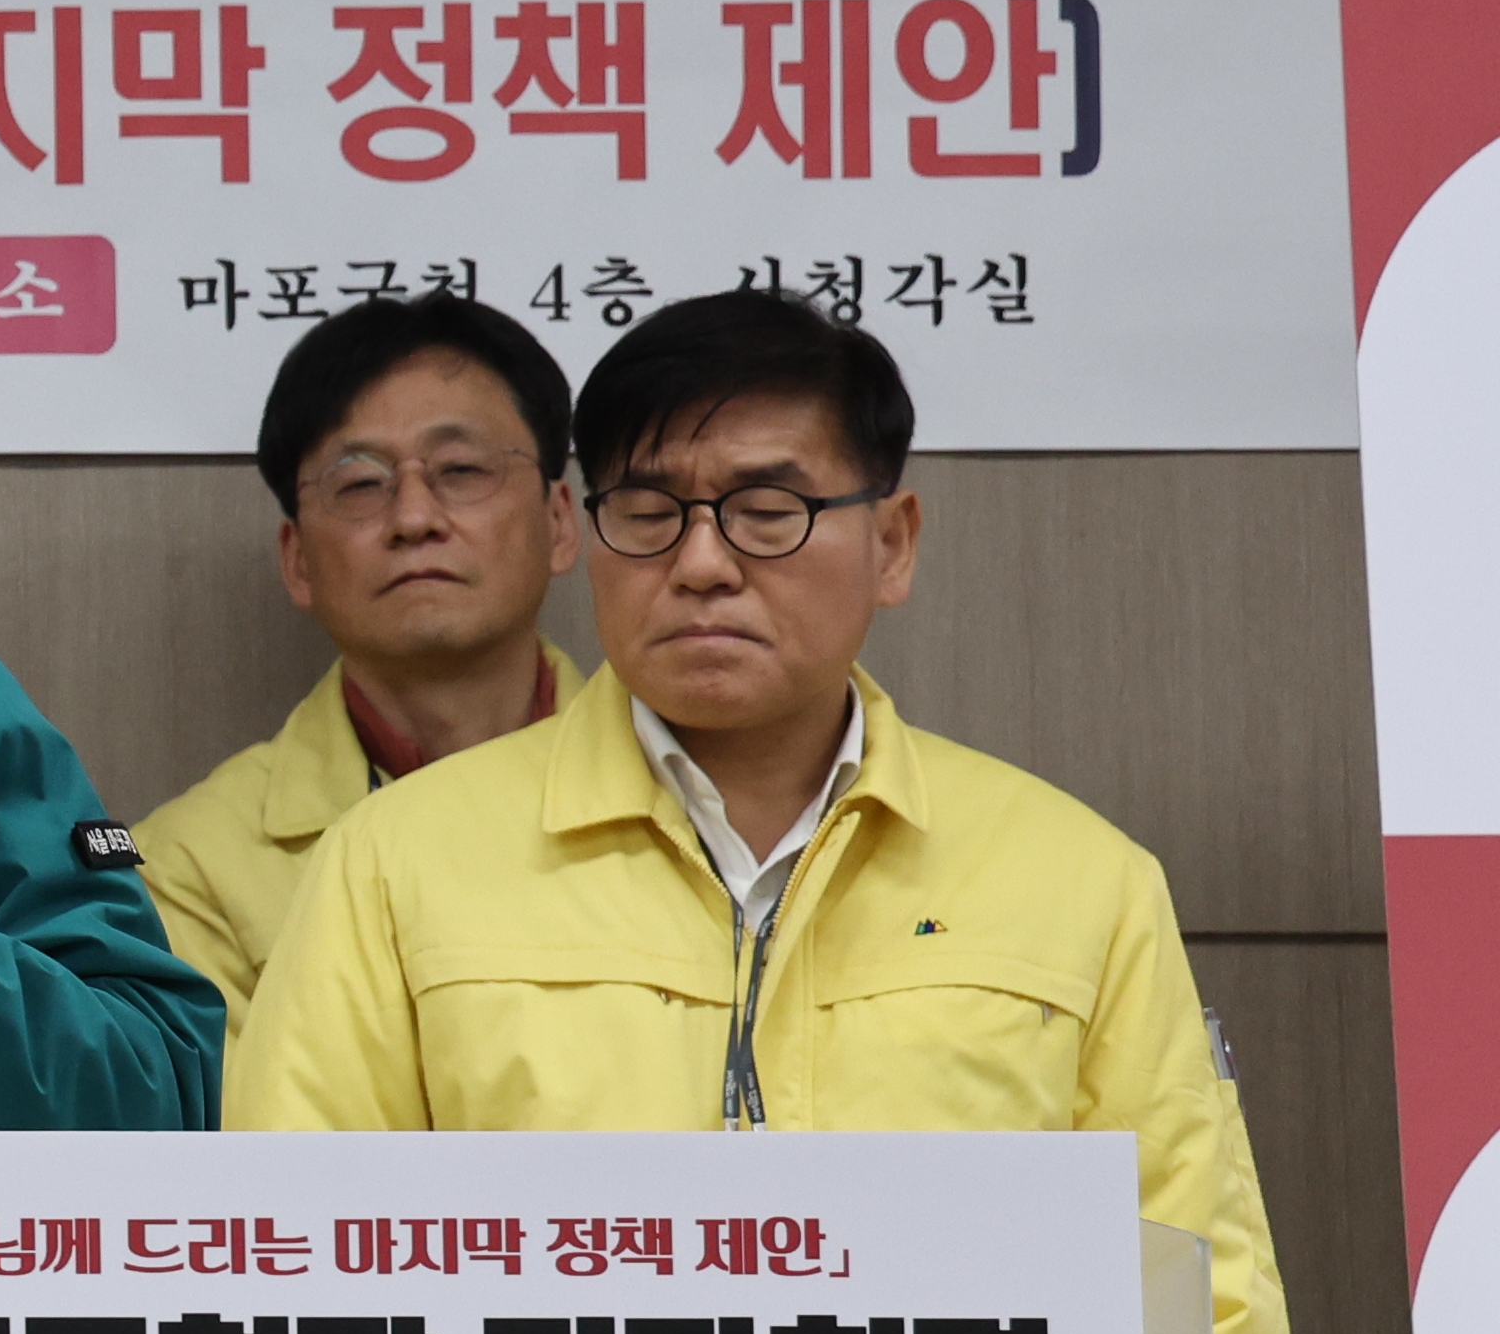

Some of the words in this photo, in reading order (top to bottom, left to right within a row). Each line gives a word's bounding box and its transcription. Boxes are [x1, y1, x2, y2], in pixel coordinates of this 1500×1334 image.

[327, 1, 646, 182] 정책
[529, 257, 653, 328] 4층
[124, 1218, 312, 1276] 드리는
[334, 1218, 527, 1275] 마지막
[546, 1217, 673, 1276] 정책
